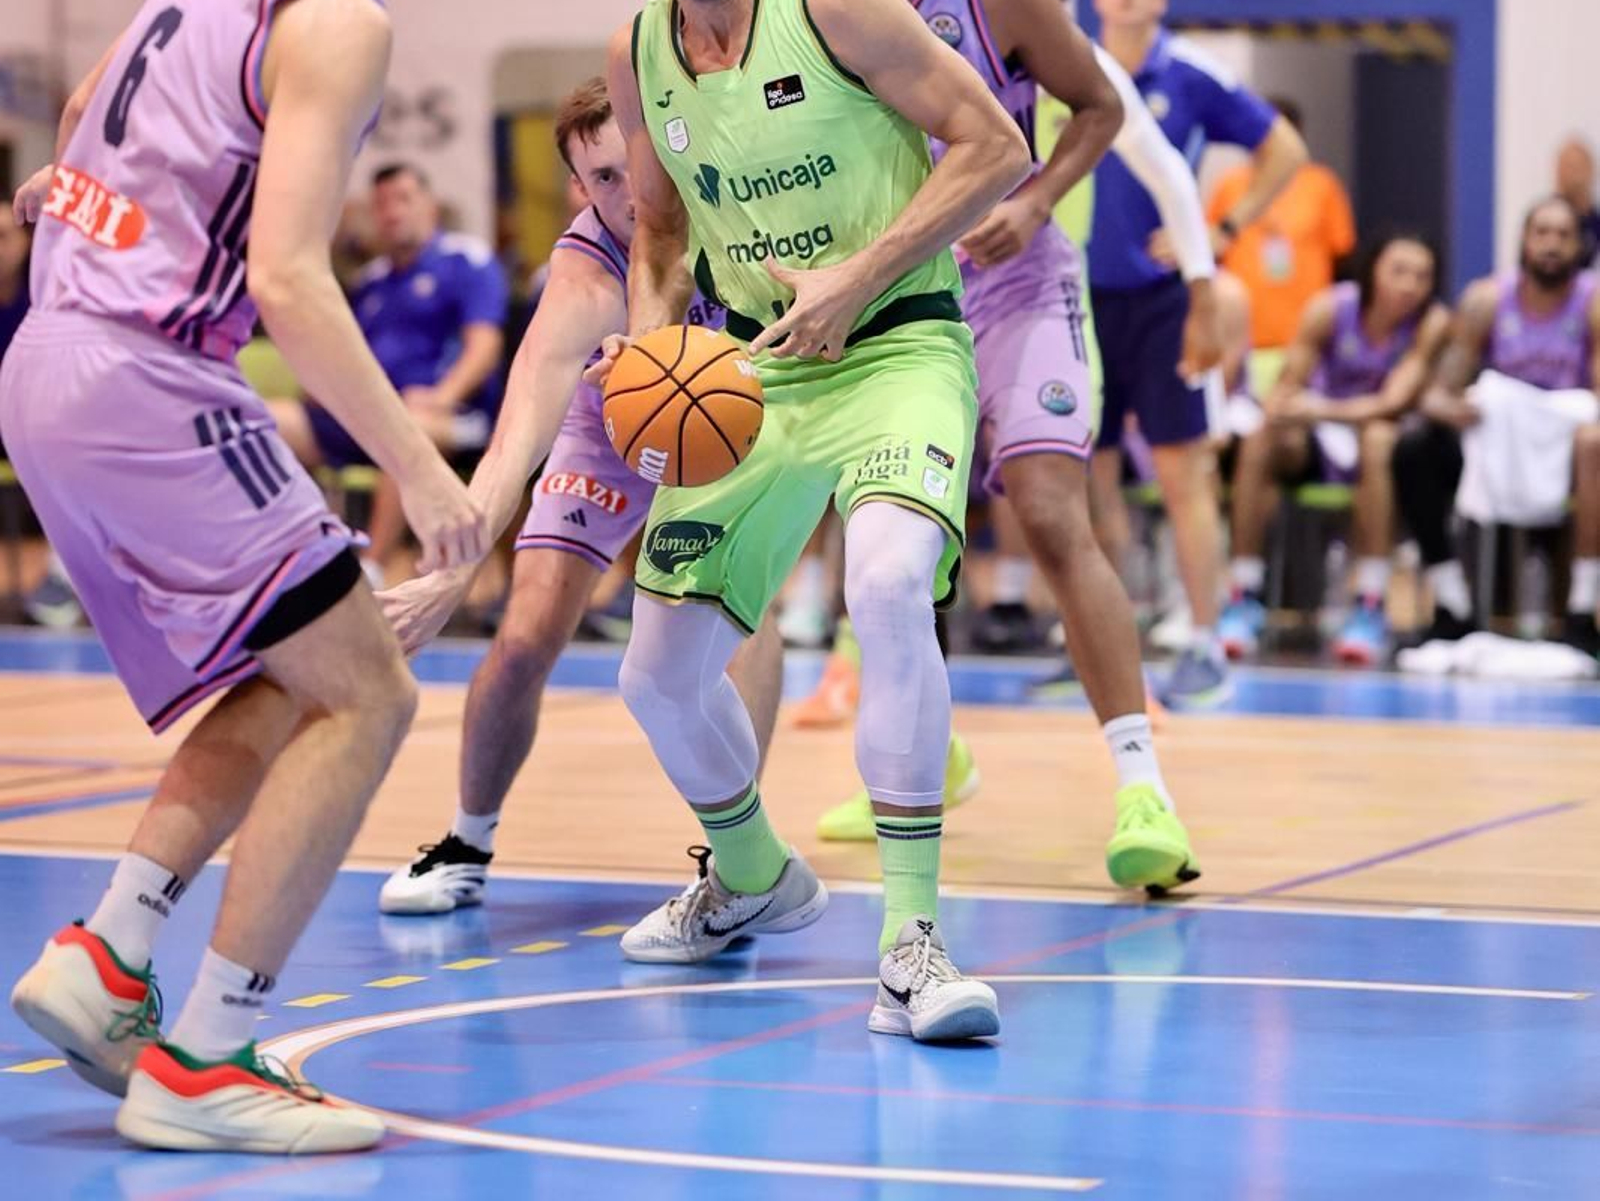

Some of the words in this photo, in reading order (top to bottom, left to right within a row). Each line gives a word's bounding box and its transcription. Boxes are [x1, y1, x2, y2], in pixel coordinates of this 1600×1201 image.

[104, 6, 183, 147] 6
[728, 154, 836, 203] Unicaja
[548, 473, 621, 512] GAZI
